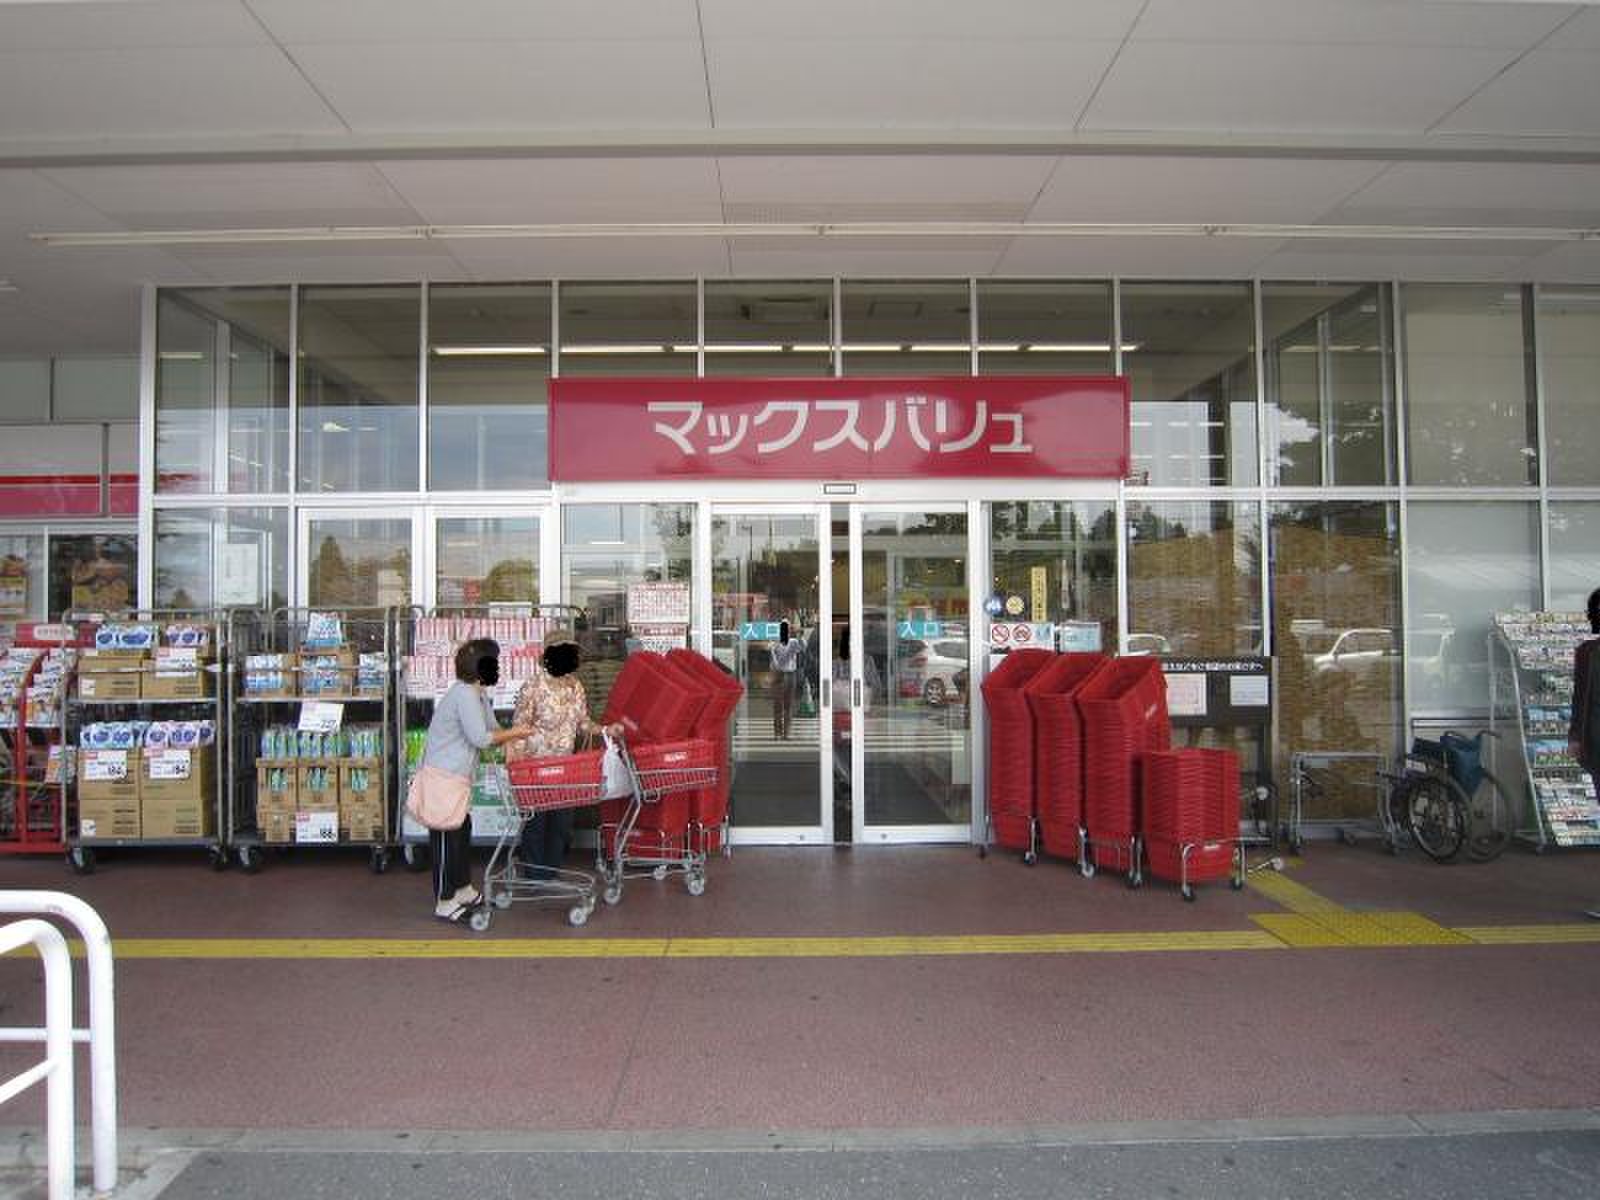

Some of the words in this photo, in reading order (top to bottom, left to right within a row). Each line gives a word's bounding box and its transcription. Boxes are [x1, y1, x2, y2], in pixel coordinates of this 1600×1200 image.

[647, 397, 1033, 455] マックスバリュ
[744, 623, 781, 639] 入口
[901, 622, 939, 639] 入口
